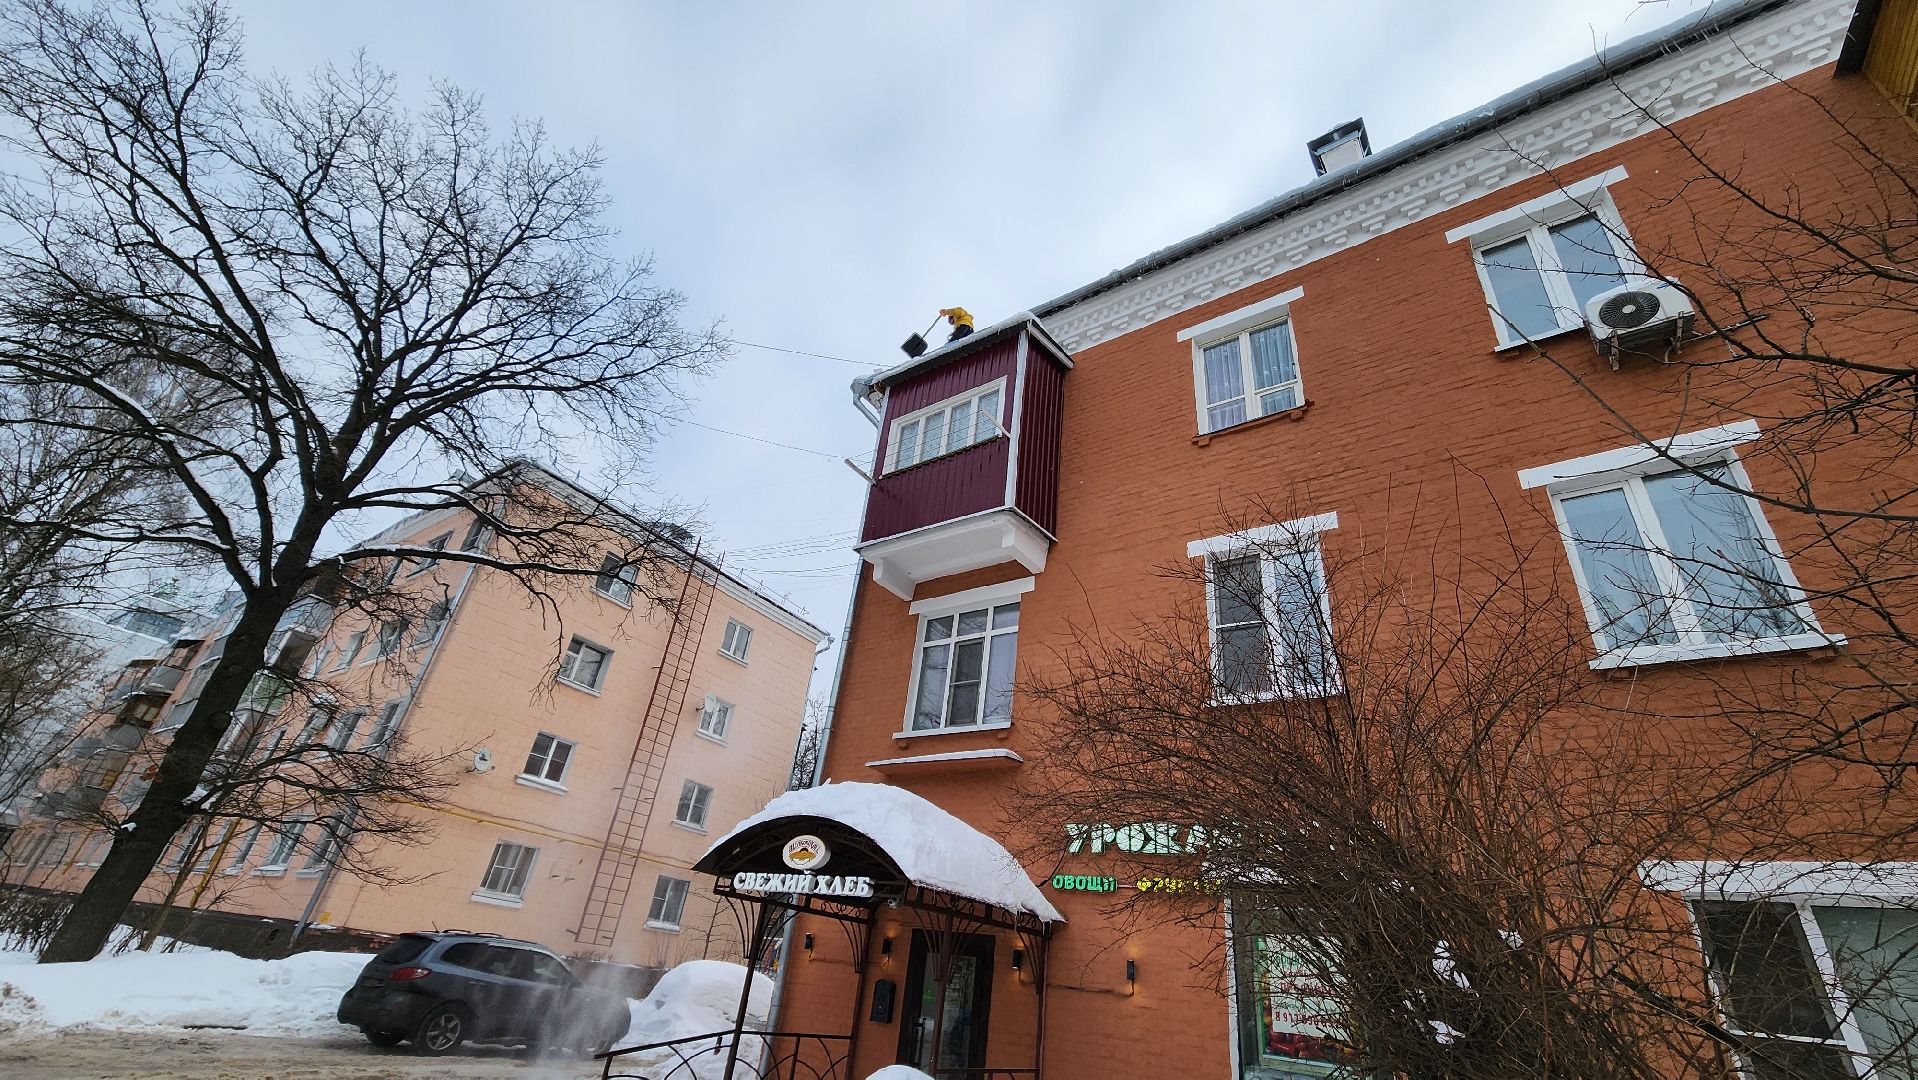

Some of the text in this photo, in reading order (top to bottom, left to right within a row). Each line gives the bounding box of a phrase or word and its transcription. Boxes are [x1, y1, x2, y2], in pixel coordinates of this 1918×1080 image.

[733, 870, 874, 897] СВЕЖИЙ ХЛЕБ
[1052, 875, 1117, 893] ОВОЩИ
